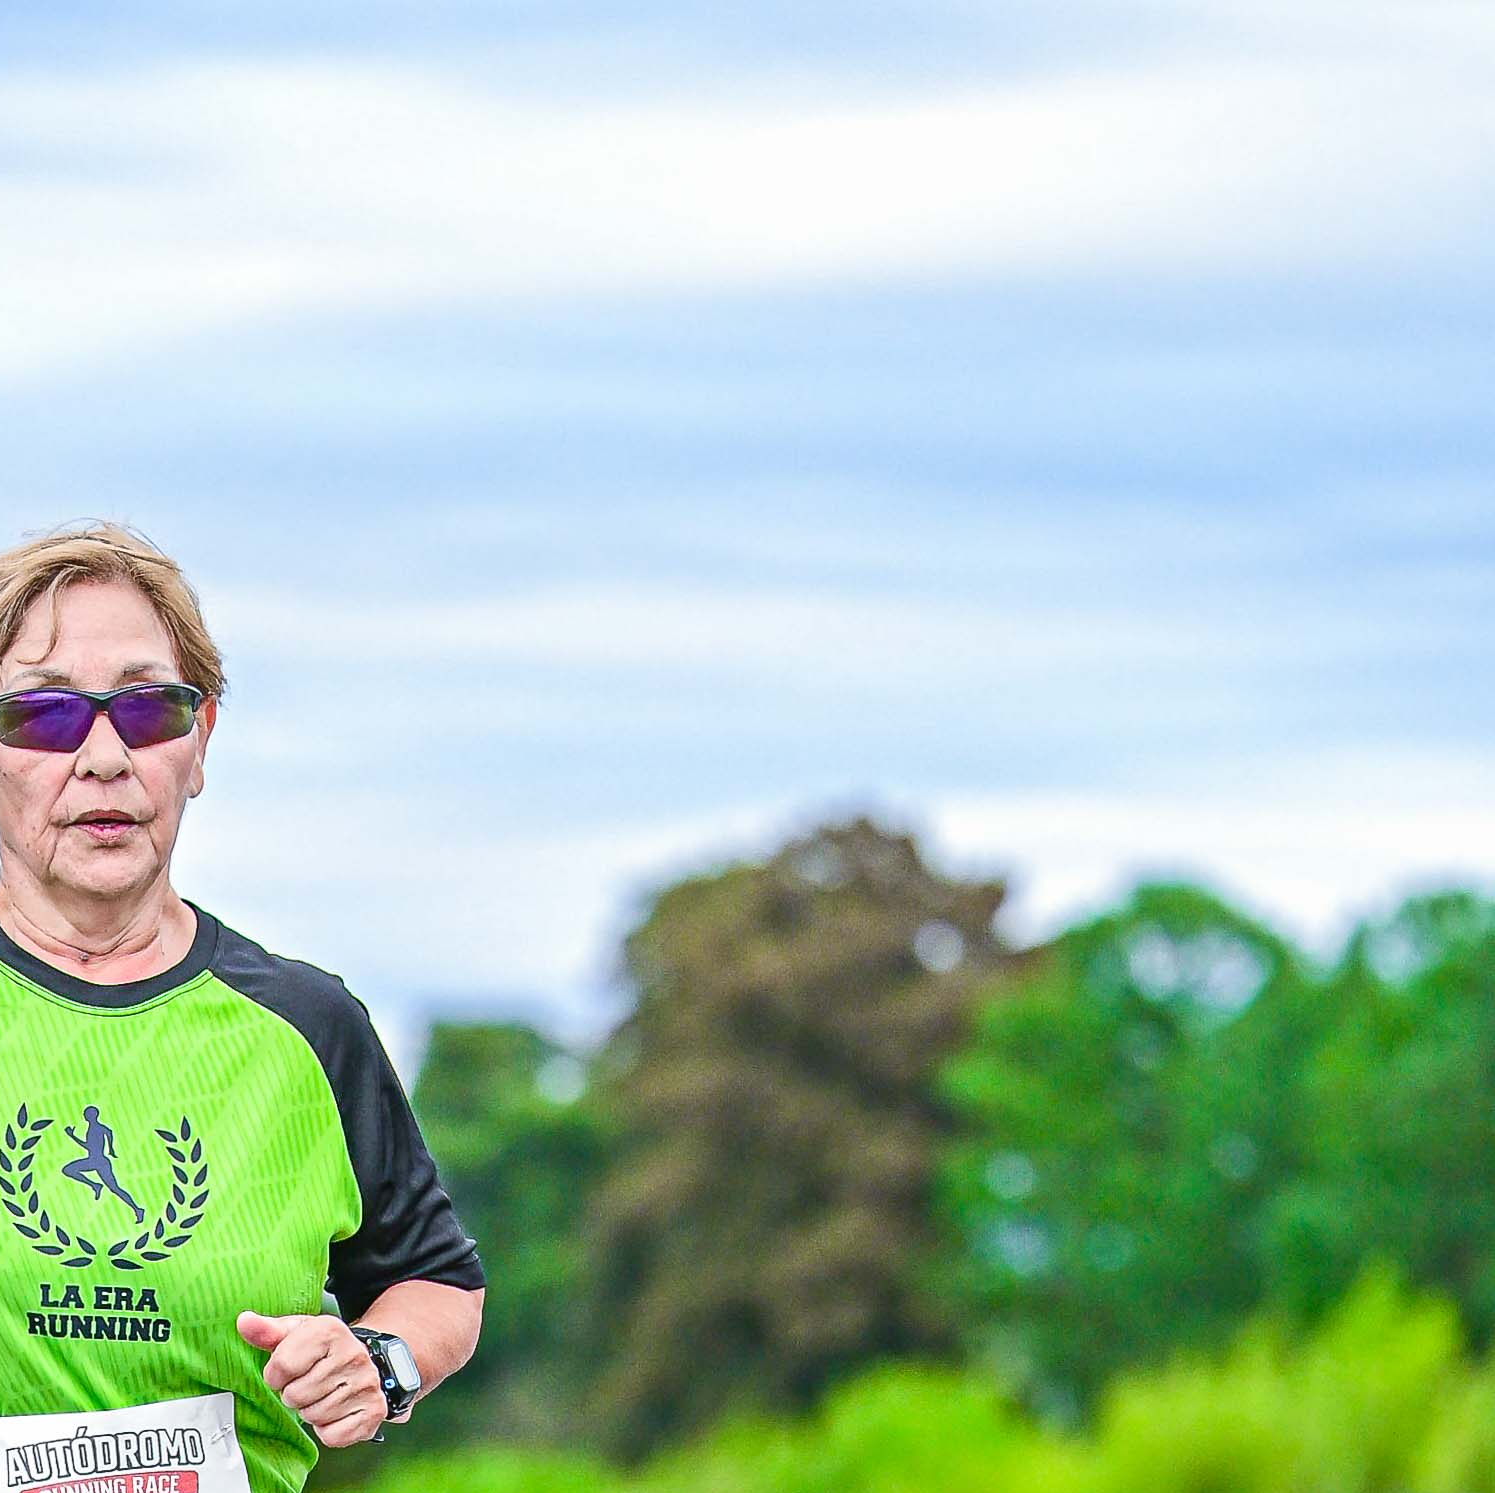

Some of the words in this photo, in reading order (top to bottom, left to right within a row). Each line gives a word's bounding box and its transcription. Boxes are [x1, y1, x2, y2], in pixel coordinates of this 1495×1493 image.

[40, 1283, 84, 1309] LA
[94, 1286, 159, 1312] ERA
[27, 1312, 171, 1342] RUNNING
[6, 1426, 205, 1487] AUTÓDROMO
